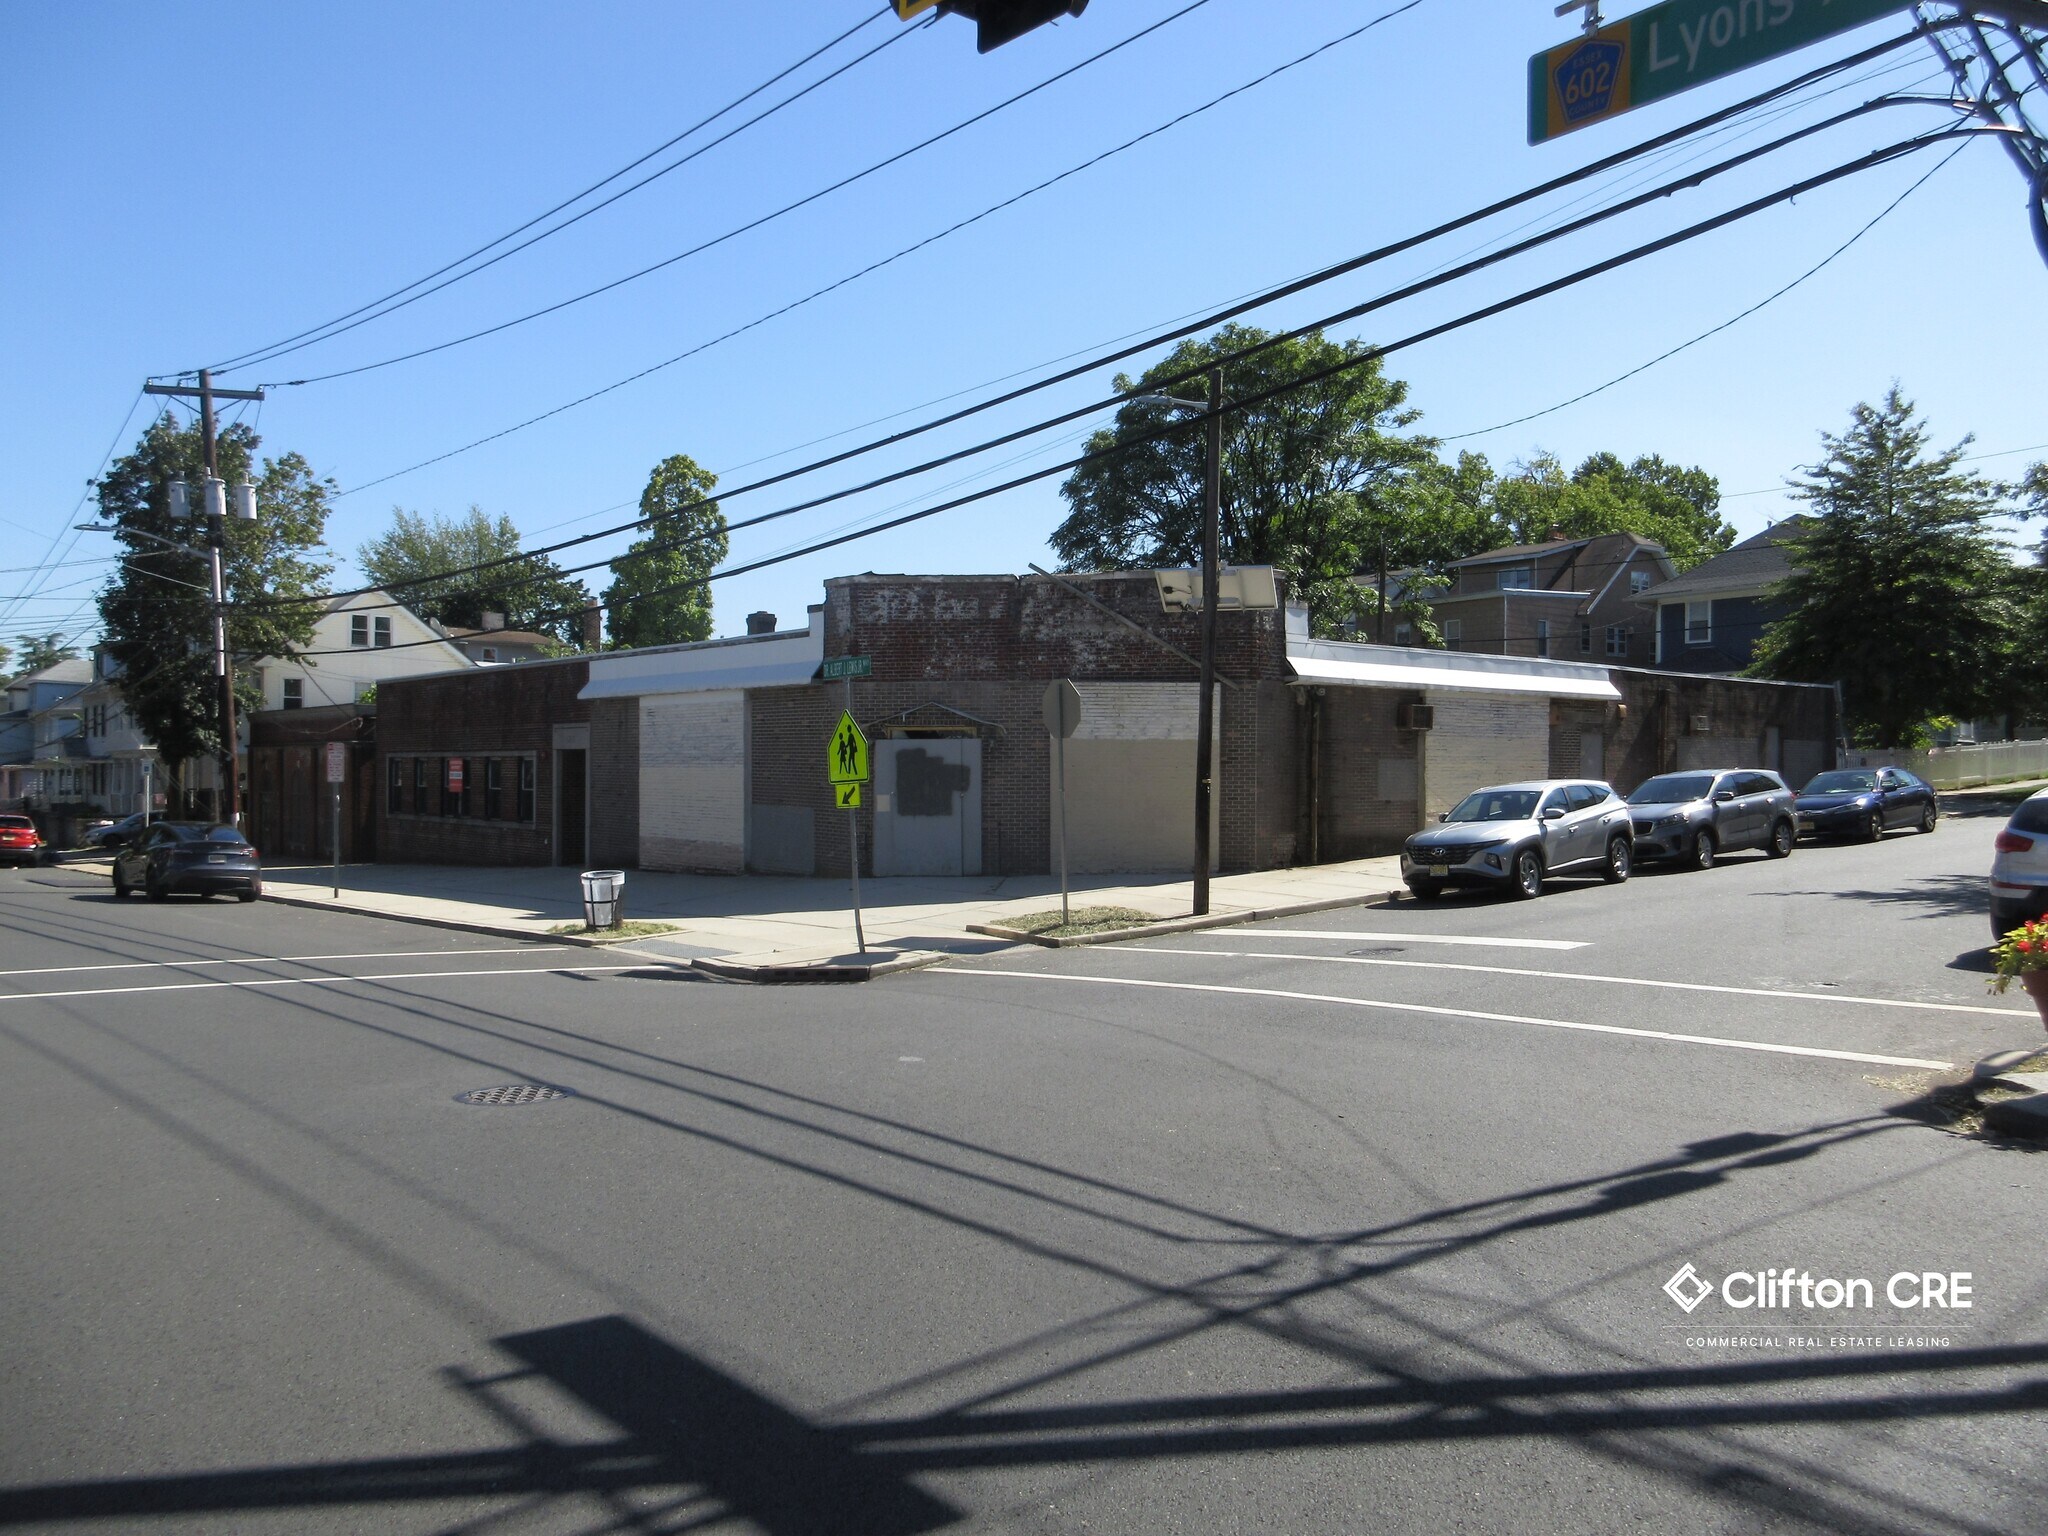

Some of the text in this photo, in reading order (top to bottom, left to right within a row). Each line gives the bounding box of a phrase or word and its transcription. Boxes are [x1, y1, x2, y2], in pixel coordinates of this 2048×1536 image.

[1648, 0, 1795, 73] Lyons
[1572, 49, 1603, 69] ESSEX
[1565, 62, 1610, 104] 602
[1568, 95, 1607, 117] COUNTY
